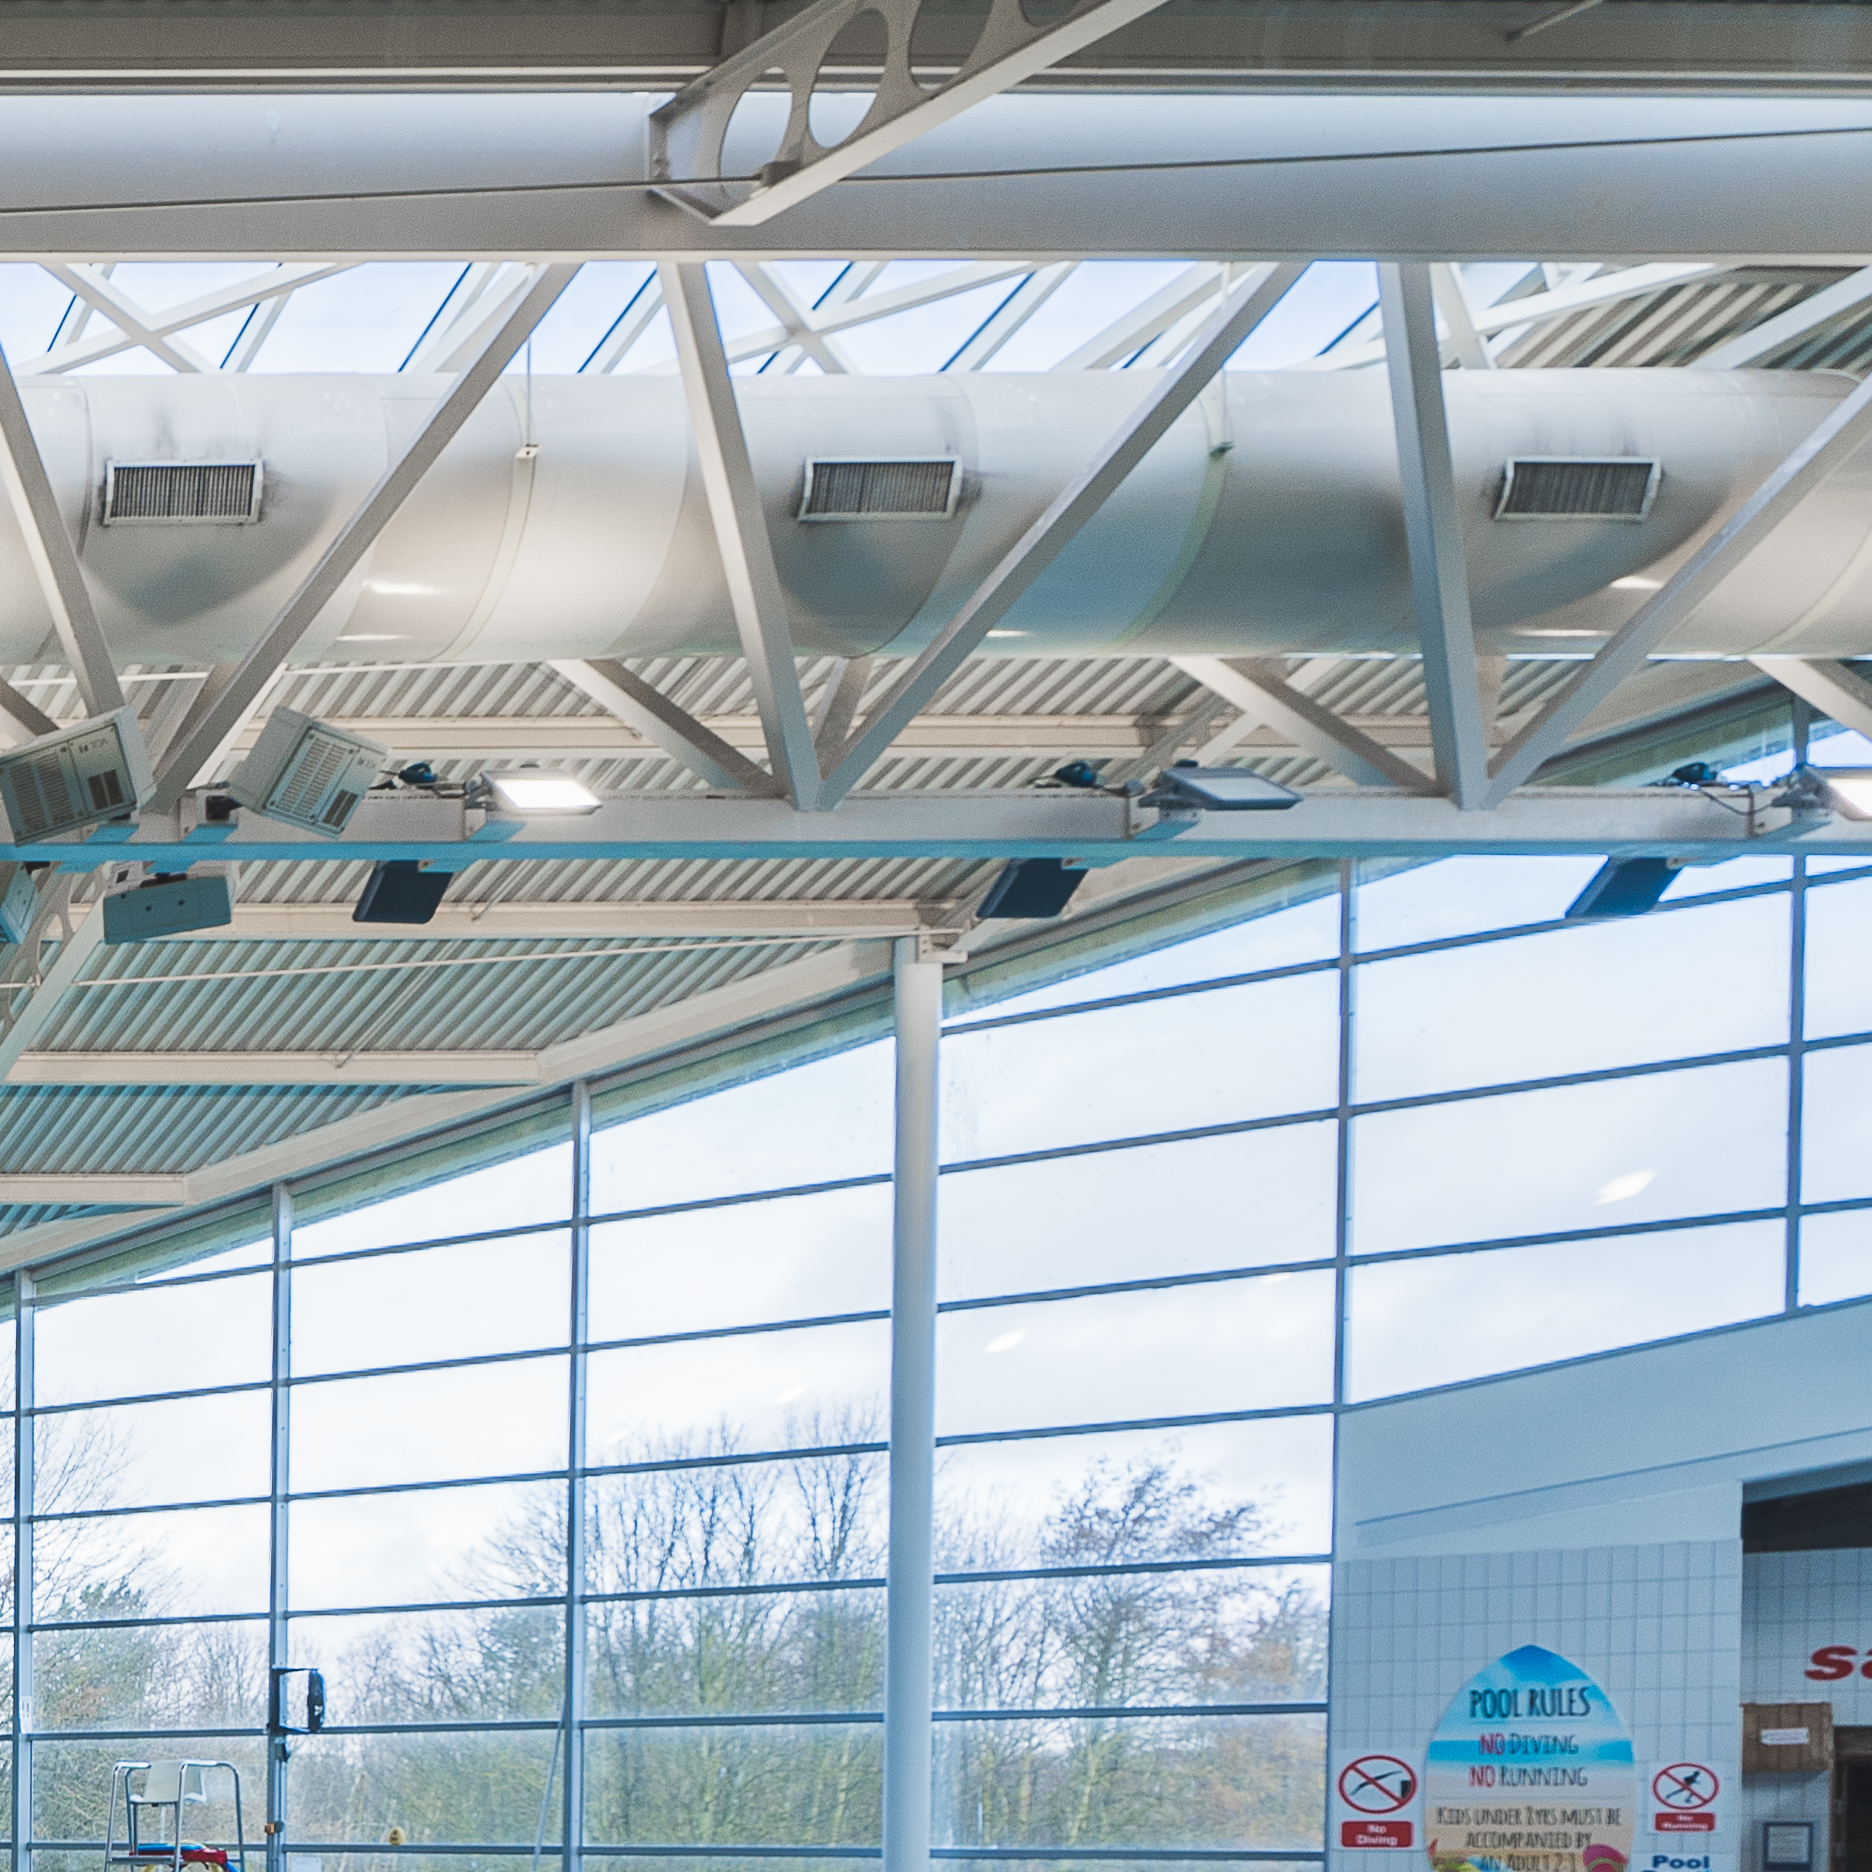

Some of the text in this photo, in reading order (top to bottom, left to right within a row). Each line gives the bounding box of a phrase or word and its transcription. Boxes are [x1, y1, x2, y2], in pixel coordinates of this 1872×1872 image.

[1804, 1645, 1872, 1681] s
[1469, 1686, 1591, 1718] POOL RULES
[1479, 1732, 1579, 1756] NO DIVING
[1469, 1765, 1588, 1788] NO RUNNING
[1436, 1805, 1472, 1825] KIDS
[1474, 1807, 1522, 1826] UNDER
[1559, 1807, 1603, 1826] MUST
[1356, 1834, 1398, 1846] Diving
[1465, 1831, 1573, 1849] ACCOMPANIED
[1652, 1855, 1710, 1869] Pool
